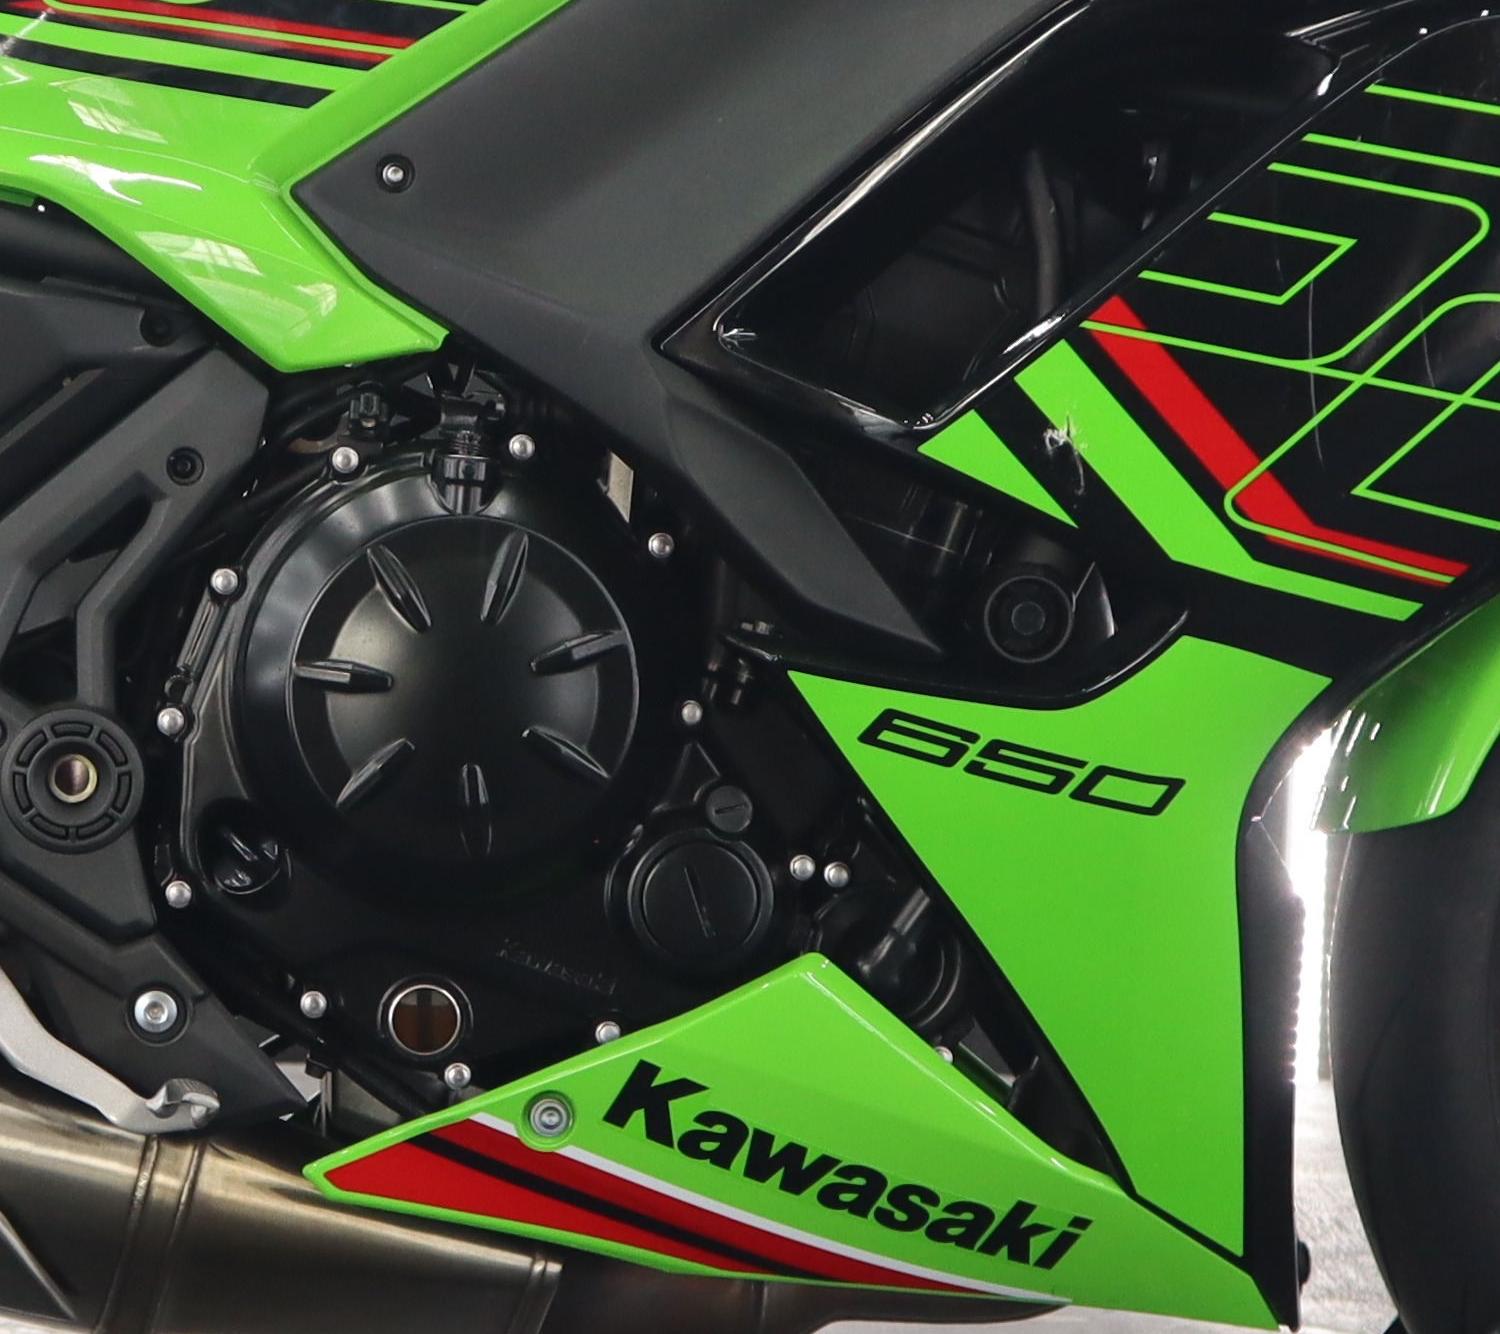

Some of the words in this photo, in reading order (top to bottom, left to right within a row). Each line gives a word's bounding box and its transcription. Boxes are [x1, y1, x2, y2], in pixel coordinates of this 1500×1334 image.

[857, 708, 1187, 817] 650
[495, 937, 619, 996] Kawasaki
[602, 1059, 1094, 1271] Kawasaki
